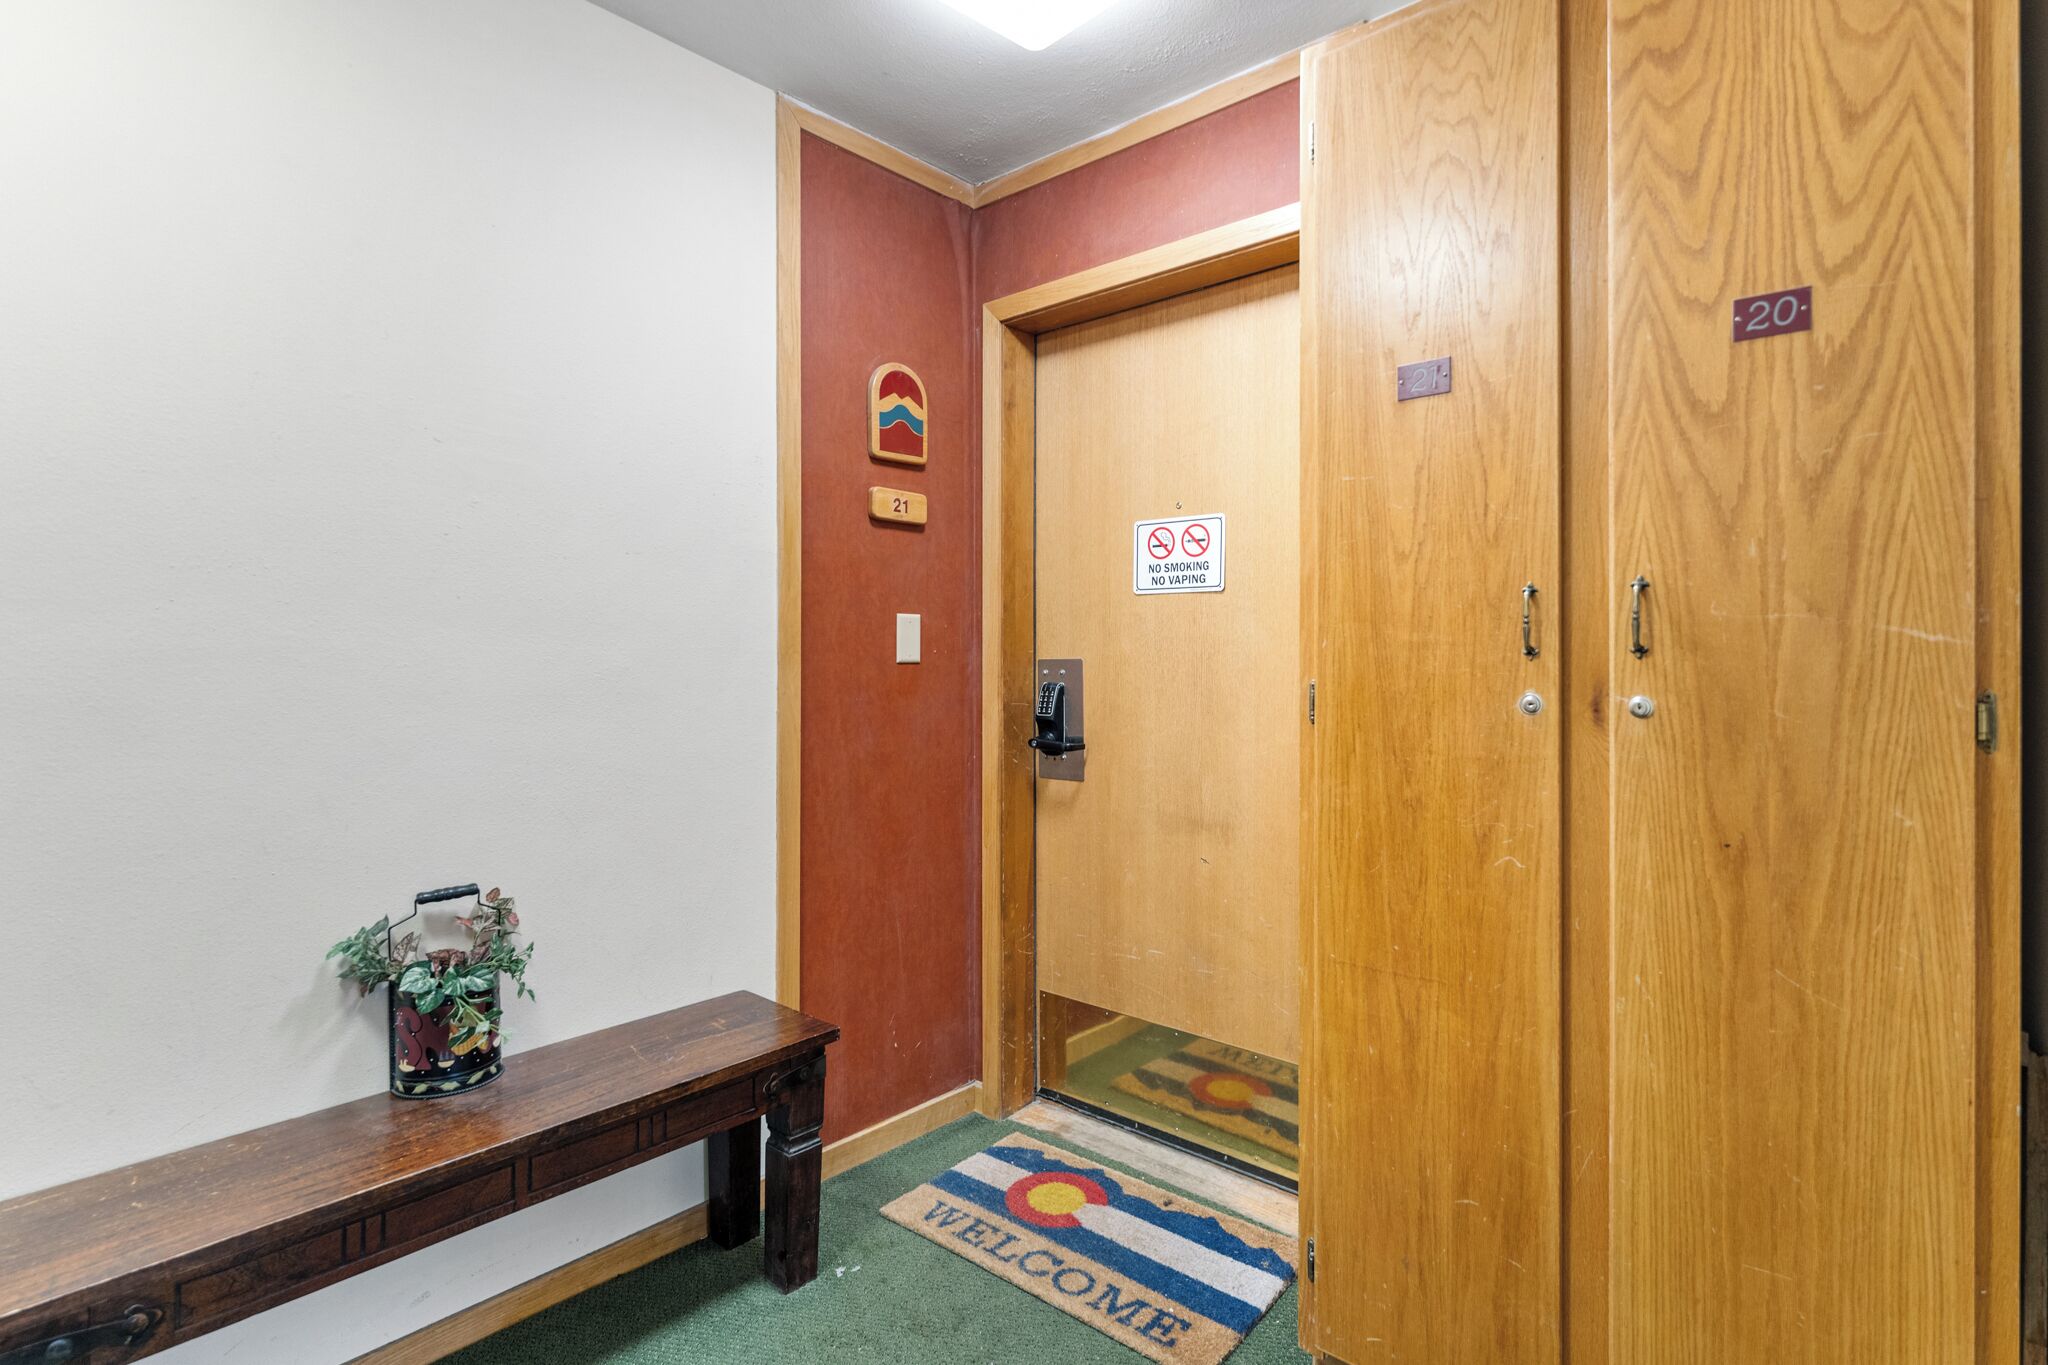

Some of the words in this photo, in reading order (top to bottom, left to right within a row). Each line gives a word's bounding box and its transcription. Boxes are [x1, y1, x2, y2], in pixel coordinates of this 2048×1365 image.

[1746, 296, 1798, 331] 20
[1410, 365, 1441, 393] 21
[893, 498, 909, 514] 21
[1148, 563, 1162, 574] NO
[1164, 560, 1209, 573] SMOKING
[1151, 576, 1165, 586] NO
[1168, 574, 1206, 585] VAPING
[922, 1200, 1193, 1346] WELCOME
